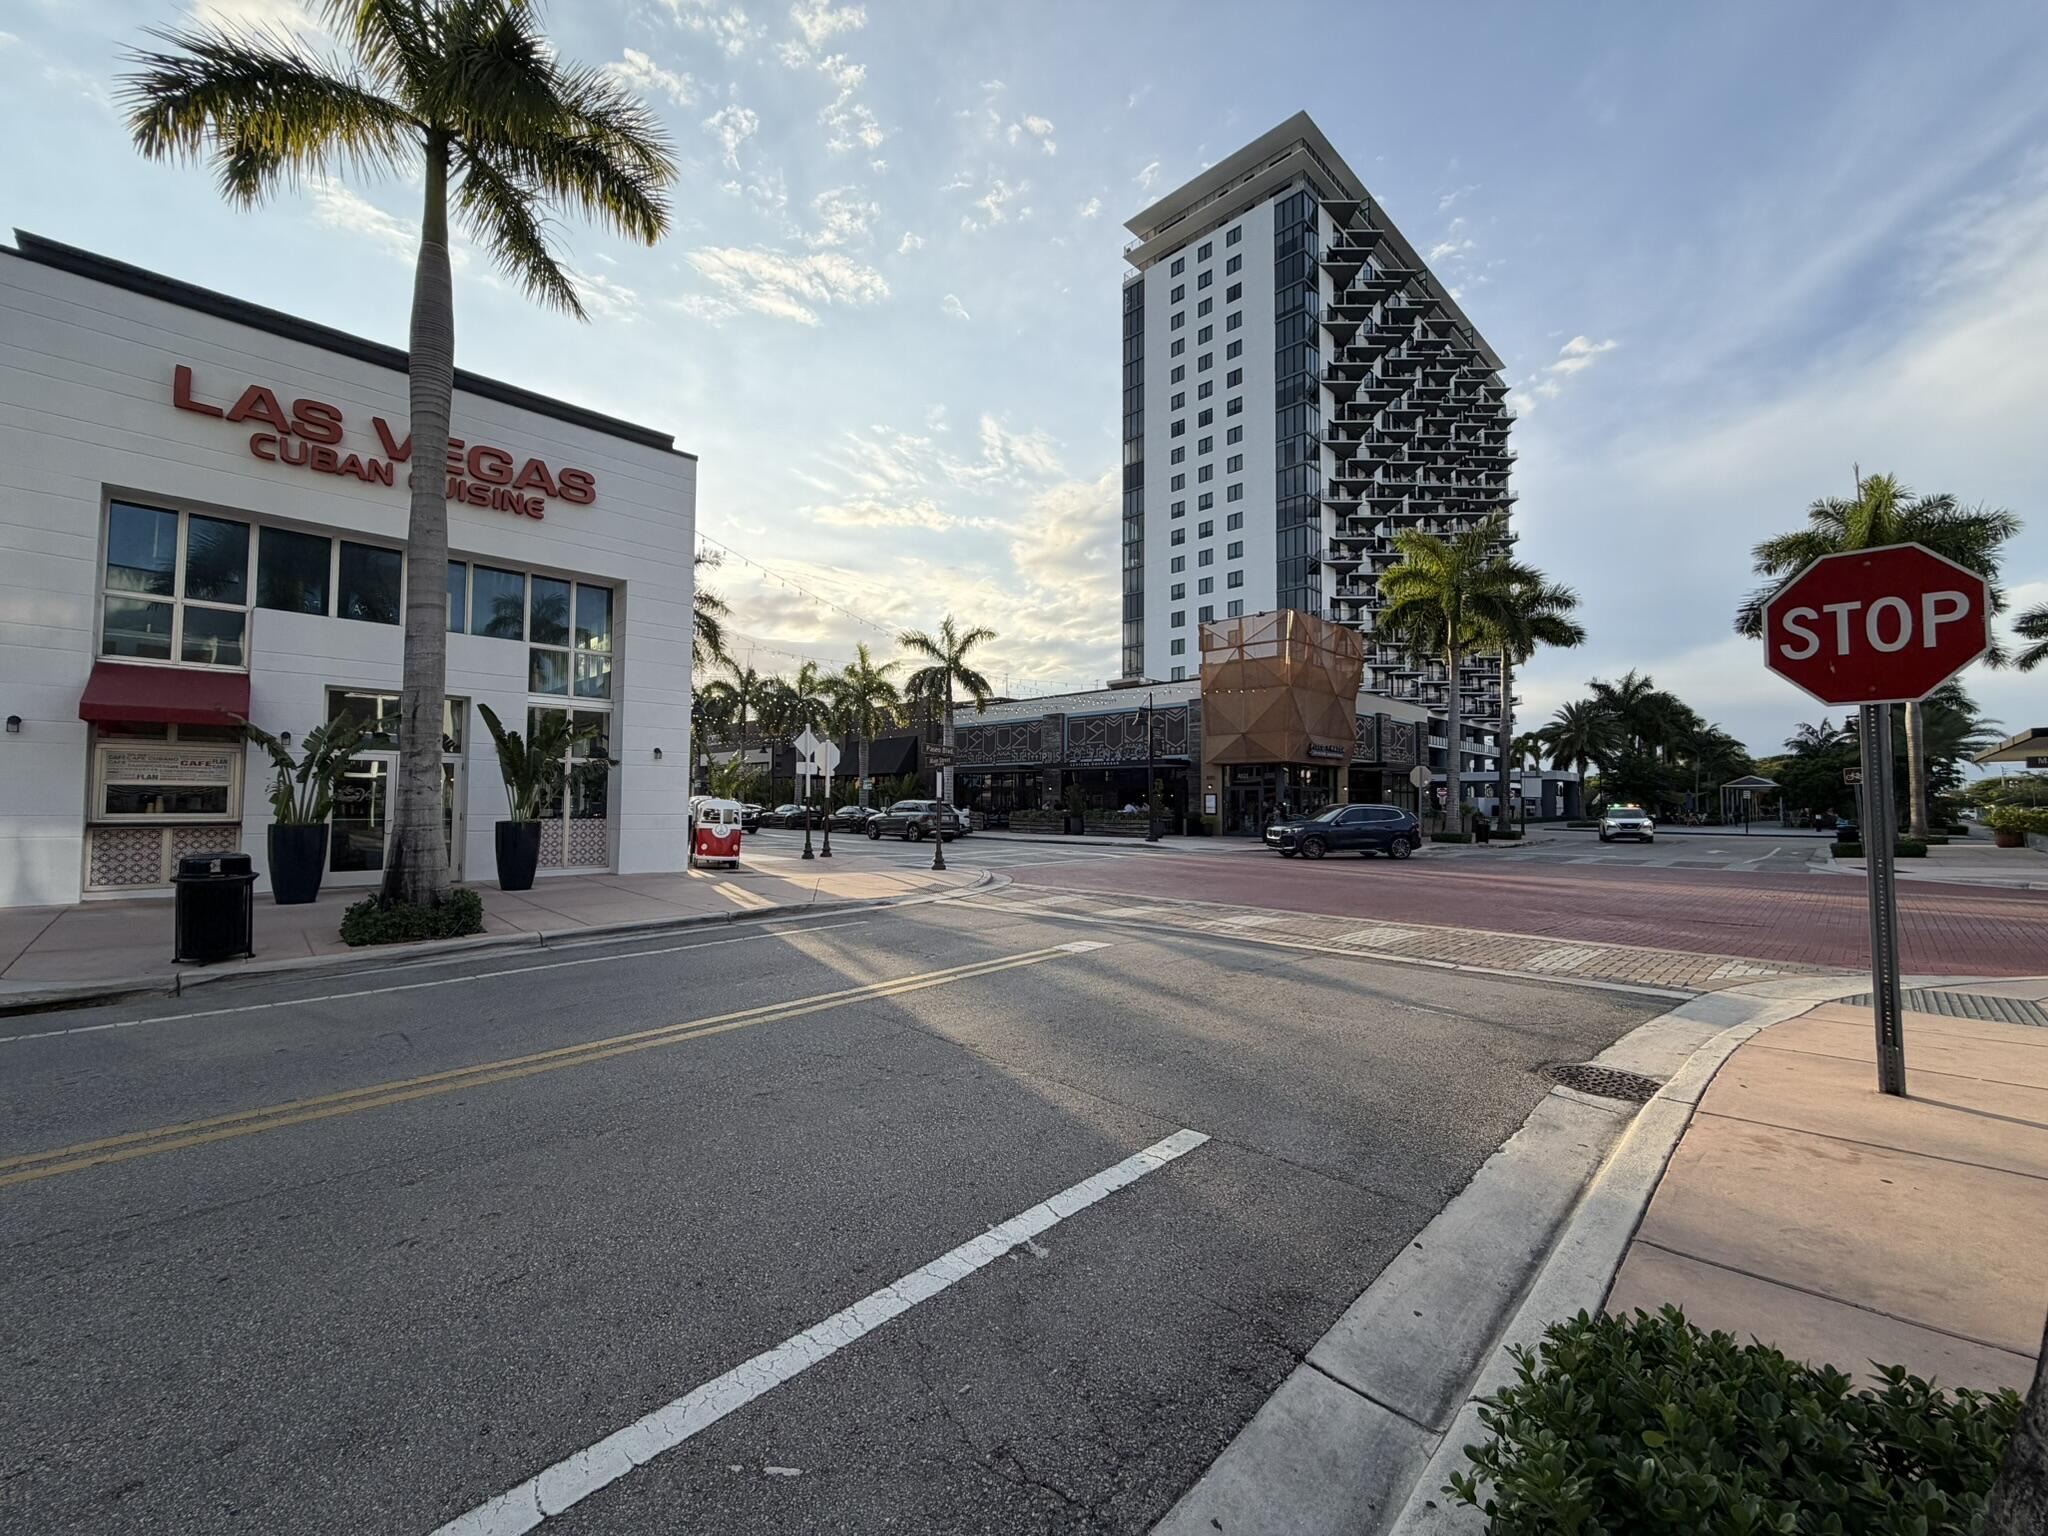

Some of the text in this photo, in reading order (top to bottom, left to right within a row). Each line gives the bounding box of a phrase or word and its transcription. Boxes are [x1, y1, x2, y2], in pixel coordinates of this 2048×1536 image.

[173, 364, 343, 445] LAS
[249, 432, 545, 520] CUBAN ISINE
[1779, 590, 1970, 661] STOP
